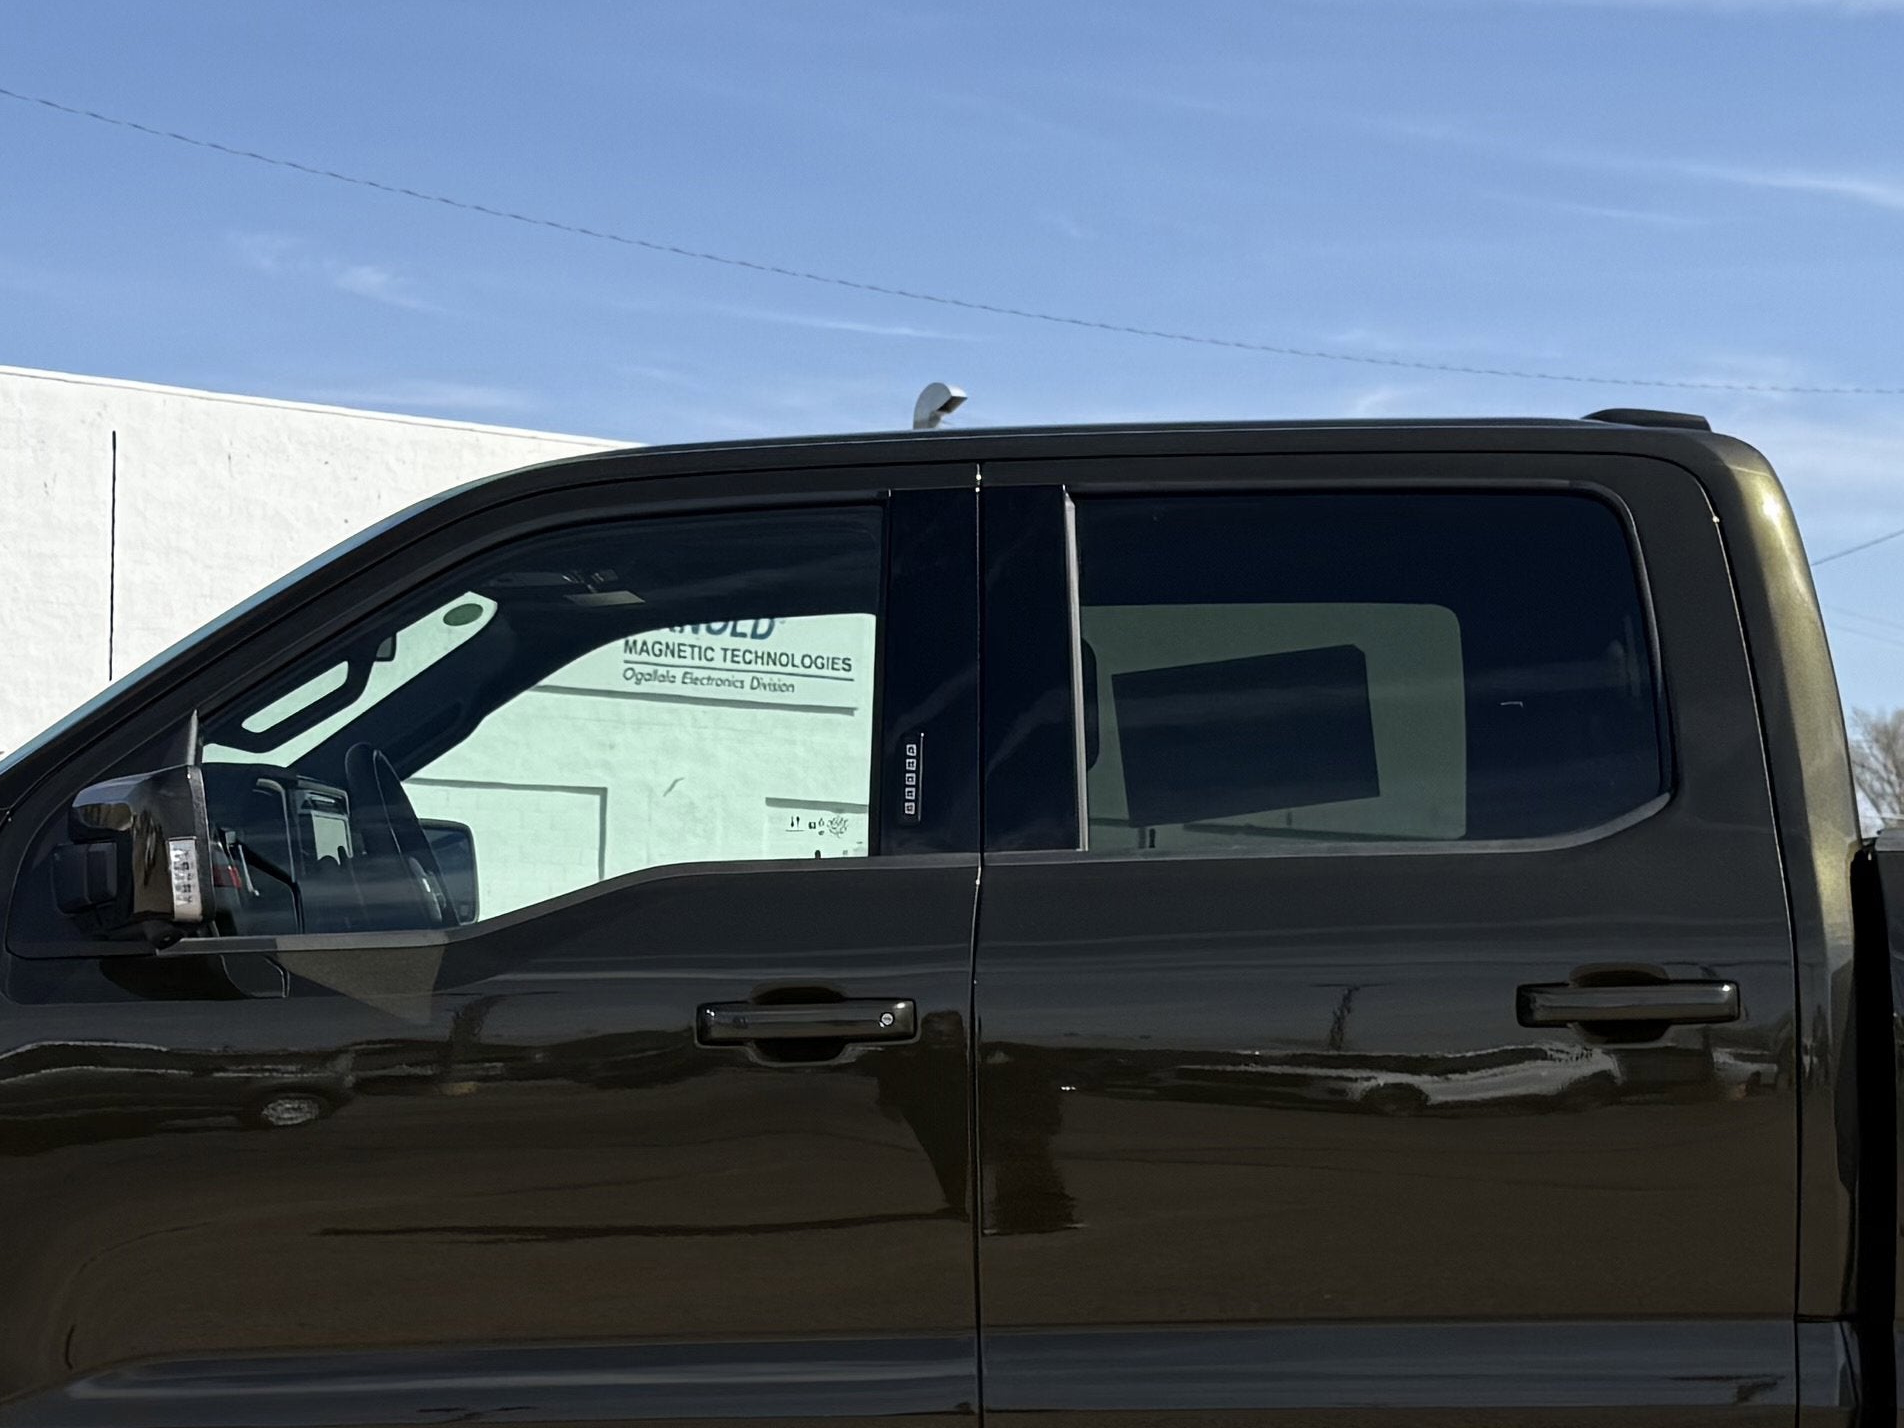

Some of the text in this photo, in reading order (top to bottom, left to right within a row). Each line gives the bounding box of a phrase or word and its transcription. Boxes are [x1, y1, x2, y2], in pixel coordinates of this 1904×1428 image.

[623, 639, 853, 673] MAGNETIC TECHNOLOGIES
[622, 666, 796, 693] Ogallala Electronics Division
